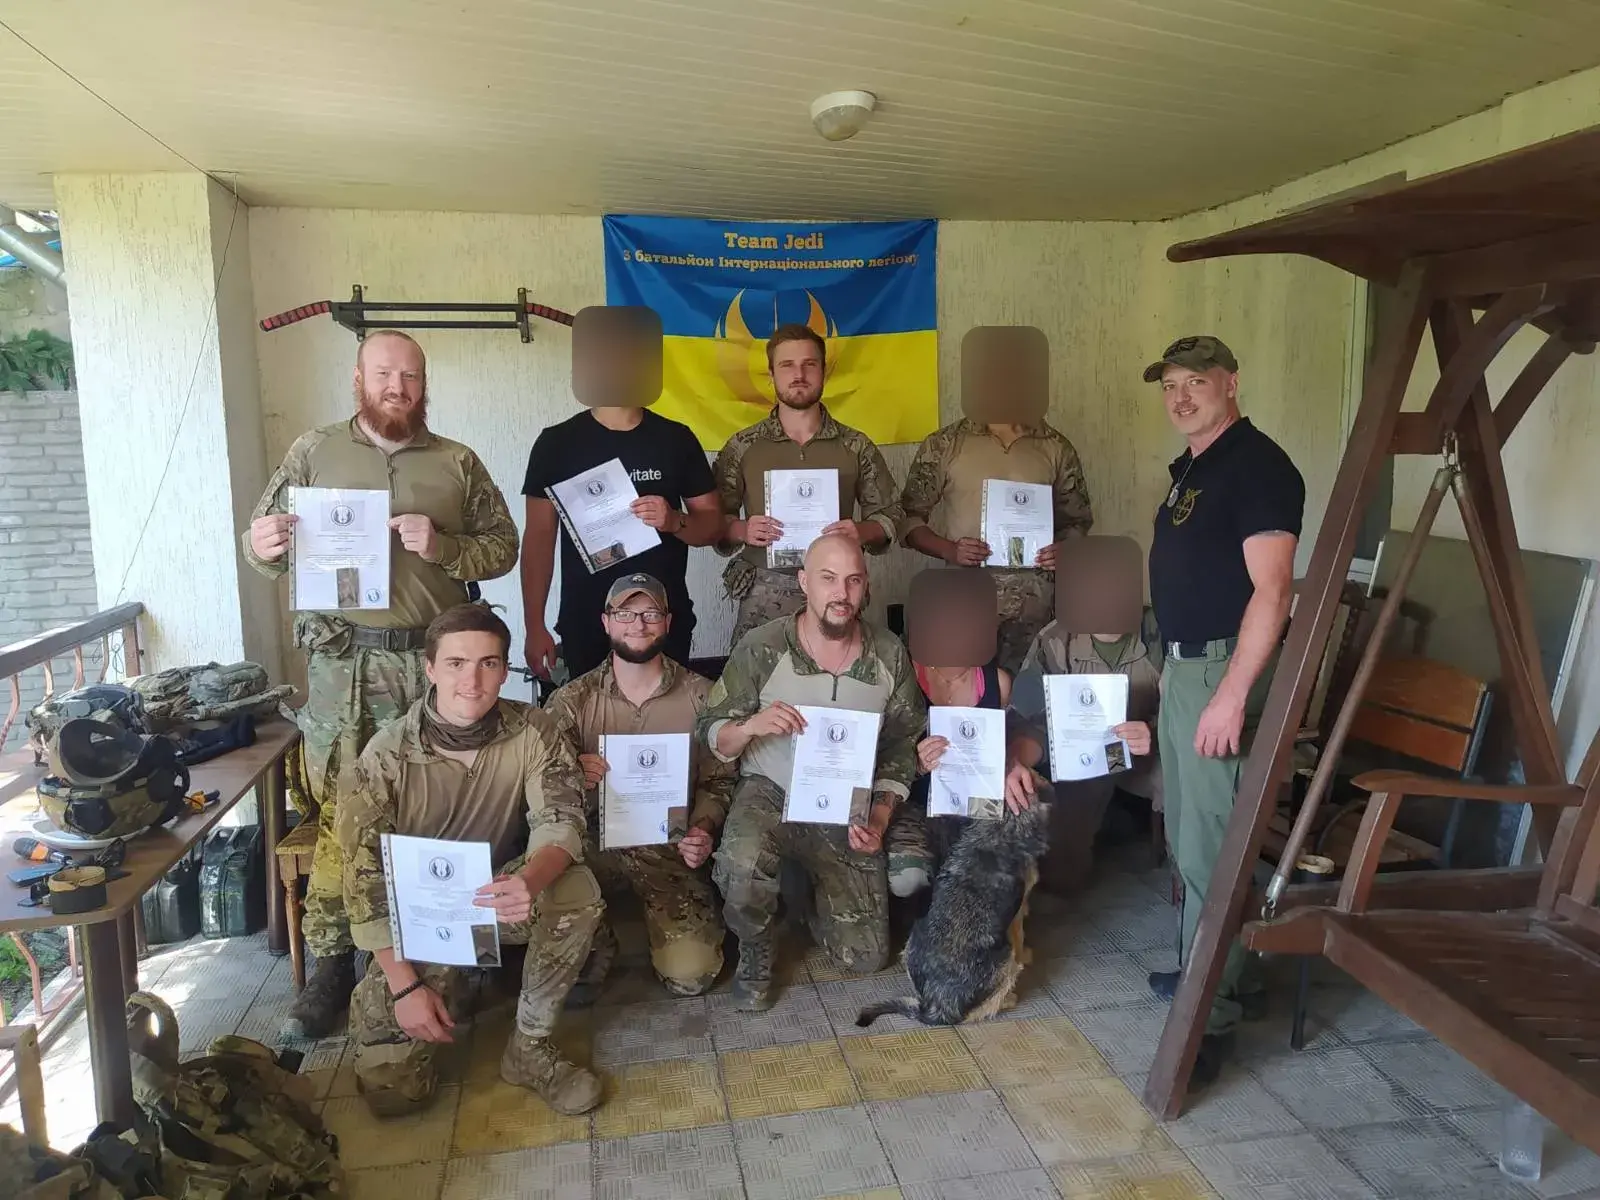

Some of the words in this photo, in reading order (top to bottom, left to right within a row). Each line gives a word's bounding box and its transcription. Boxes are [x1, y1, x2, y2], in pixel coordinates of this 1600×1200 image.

[724, 232, 778, 249] Team
[784, 232, 824, 249] Jedi
[635, 249, 714, 267] батальйон
[718, 255, 865, 272] Інтернаціонального
